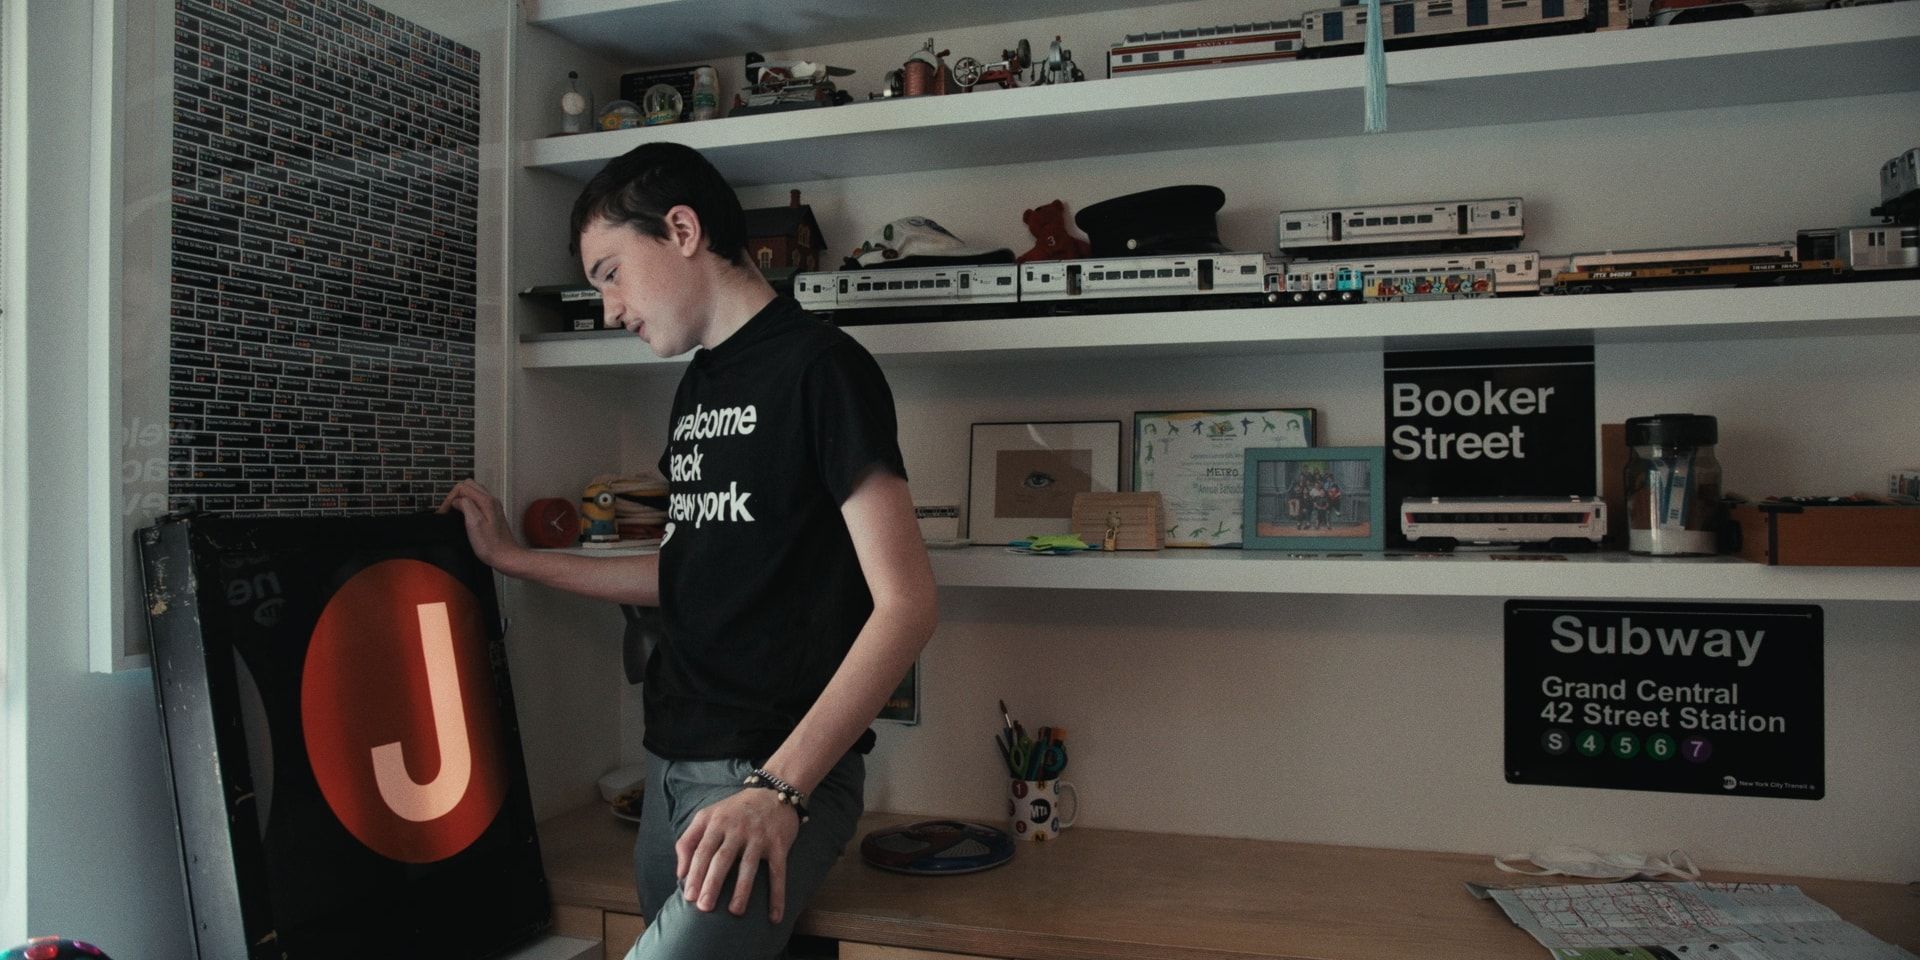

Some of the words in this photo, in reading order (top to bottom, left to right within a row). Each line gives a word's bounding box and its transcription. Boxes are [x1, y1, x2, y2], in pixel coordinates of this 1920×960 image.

[1048, 236, 1056, 246] 3
[1393, 381, 1554, 417] Booker
[1393, 425, 1524, 460] Street
[1206, 468, 1239, 477] METRO
[695, 481, 755, 529] york
[1551, 616, 1764, 667] Subway
[1542, 676, 1626, 700] Grand
[1637, 680, 1738, 704] Central
[371, 602, 471, 822] J
[1541, 701, 1573, 723] 42
[1584, 703, 1670, 728] Street
[1680, 707, 1786, 733] Station
[1548, 733, 1563, 750] S
[1583, 735, 1597, 752] 4
[1619, 737, 1632, 754] 5
[1654, 739, 1667, 756] 6
[1690, 741, 1704, 757] 7
[1785, 782, 1808, 790] Transit
